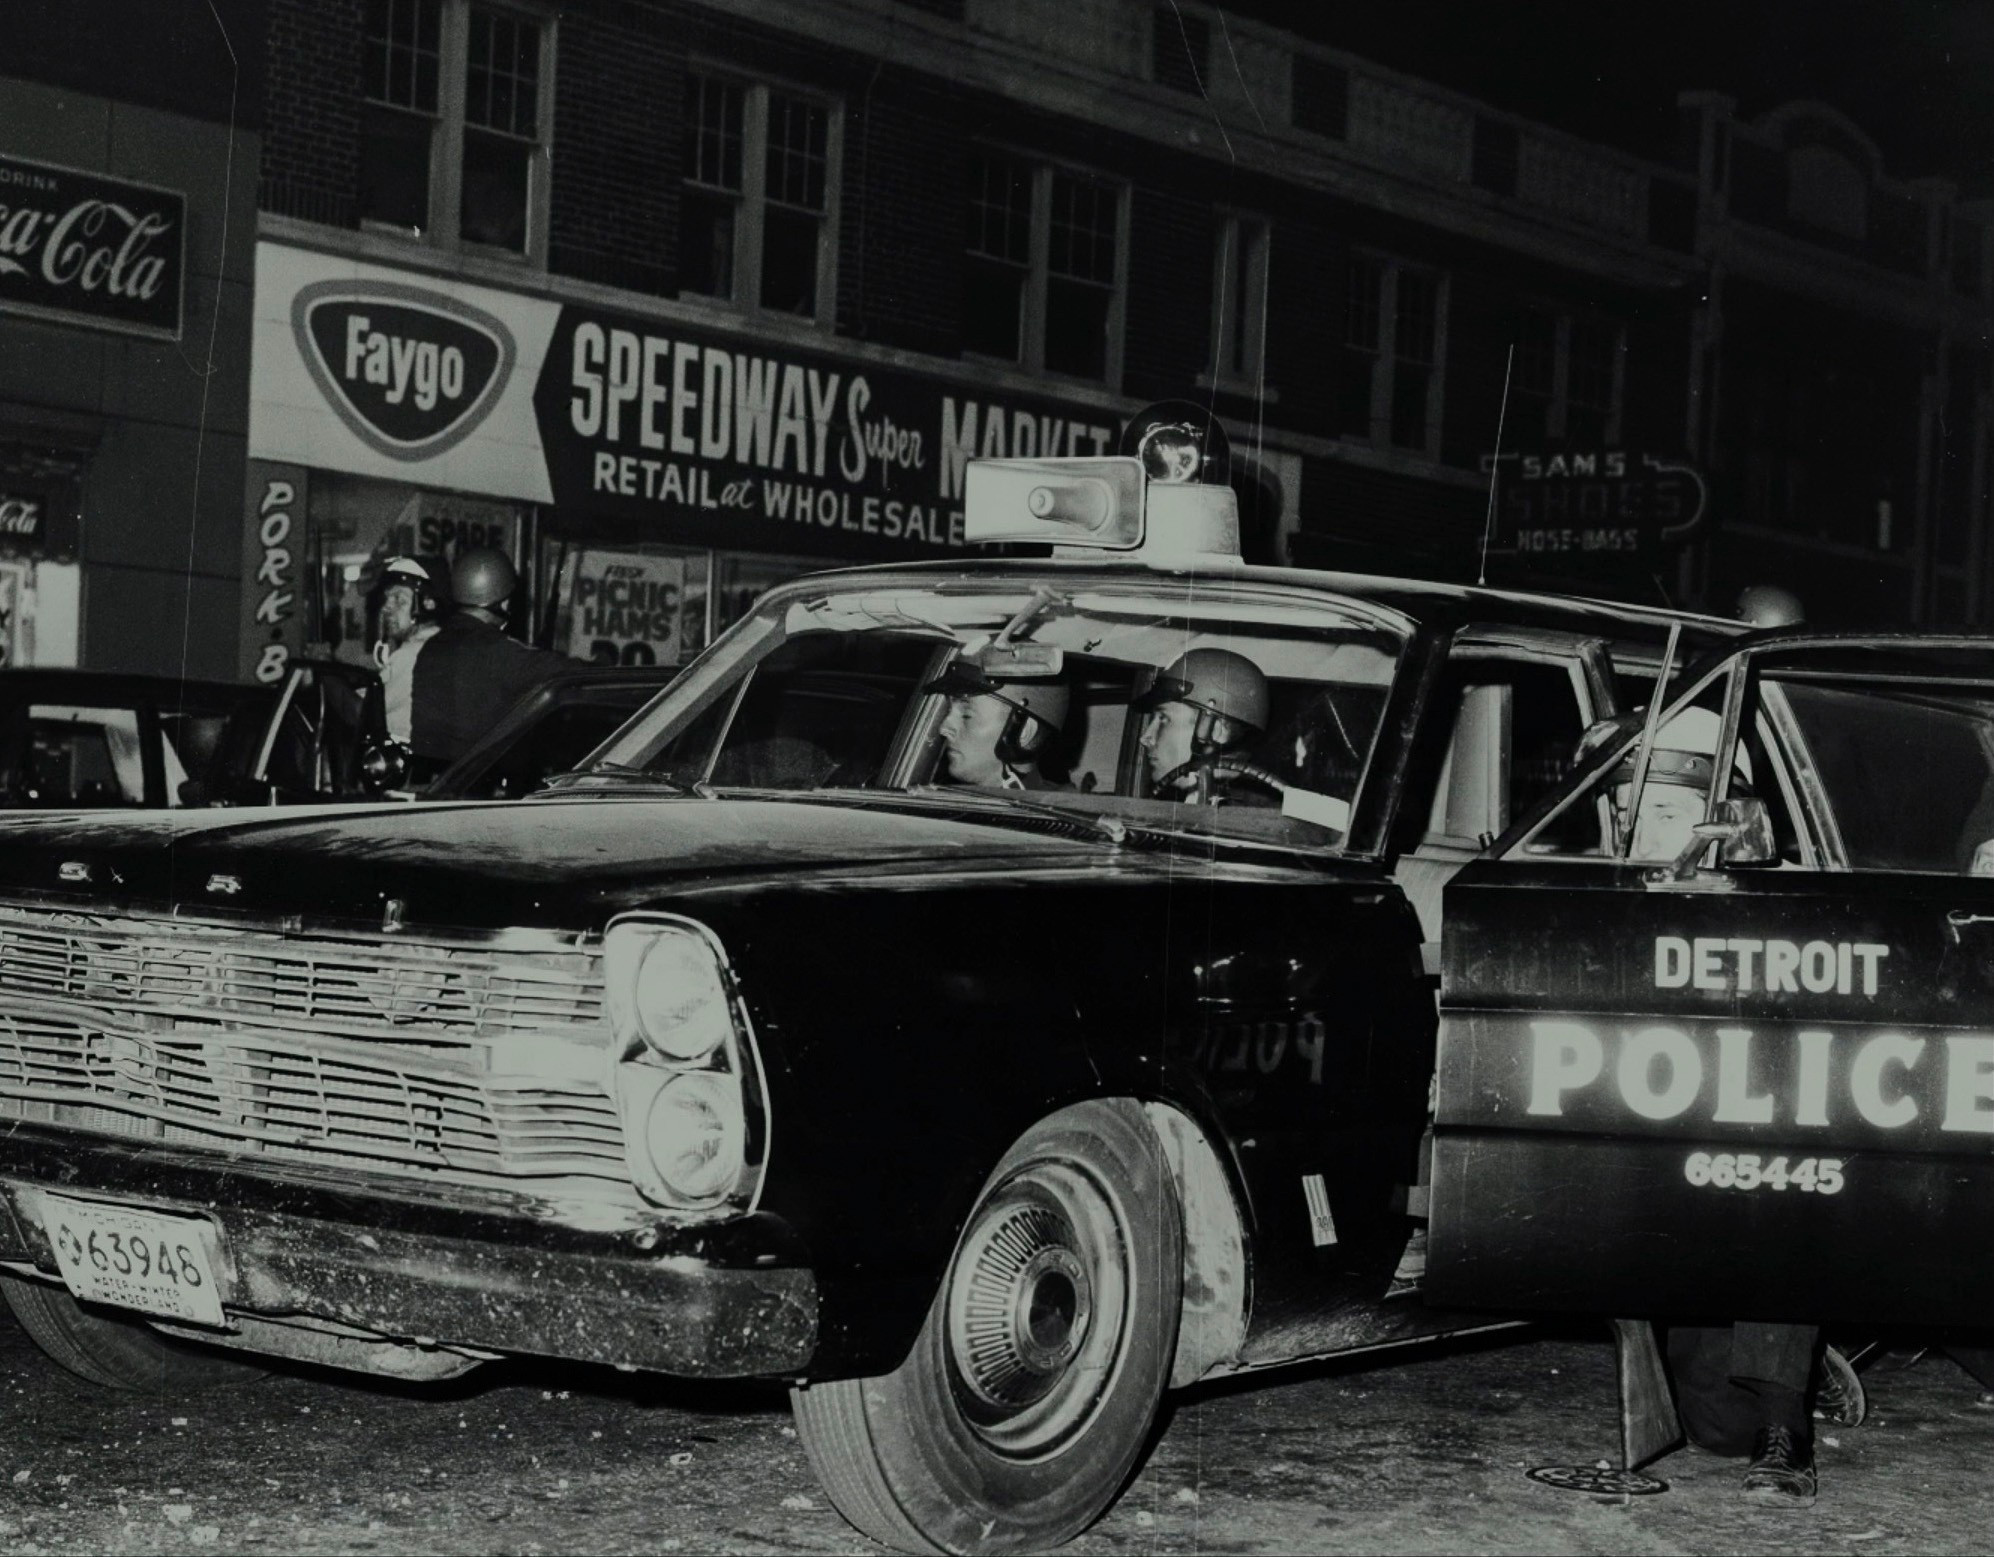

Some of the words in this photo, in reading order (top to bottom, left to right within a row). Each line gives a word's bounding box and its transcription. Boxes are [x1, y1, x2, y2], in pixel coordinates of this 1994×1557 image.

[345, 315, 464, 411] Faygo
[571, 321, 838, 478] SPEEDWAY
[839, 375, 926, 485] Super
[594, 451, 719, 507] RETAIL
[719, 477, 755, 509] at
[763, 480, 966, 548] WHOLESALE
[1507, 481, 1681, 521] SHOES
[577, 577, 679, 615] PICNIC
[583, 607, 671, 642] HAMS
[1655, 937, 1889, 995] DETROIT
[1527, 1022, 1994, 1133] POLICE
[1684, 1152, 1845, 1195] 665445
